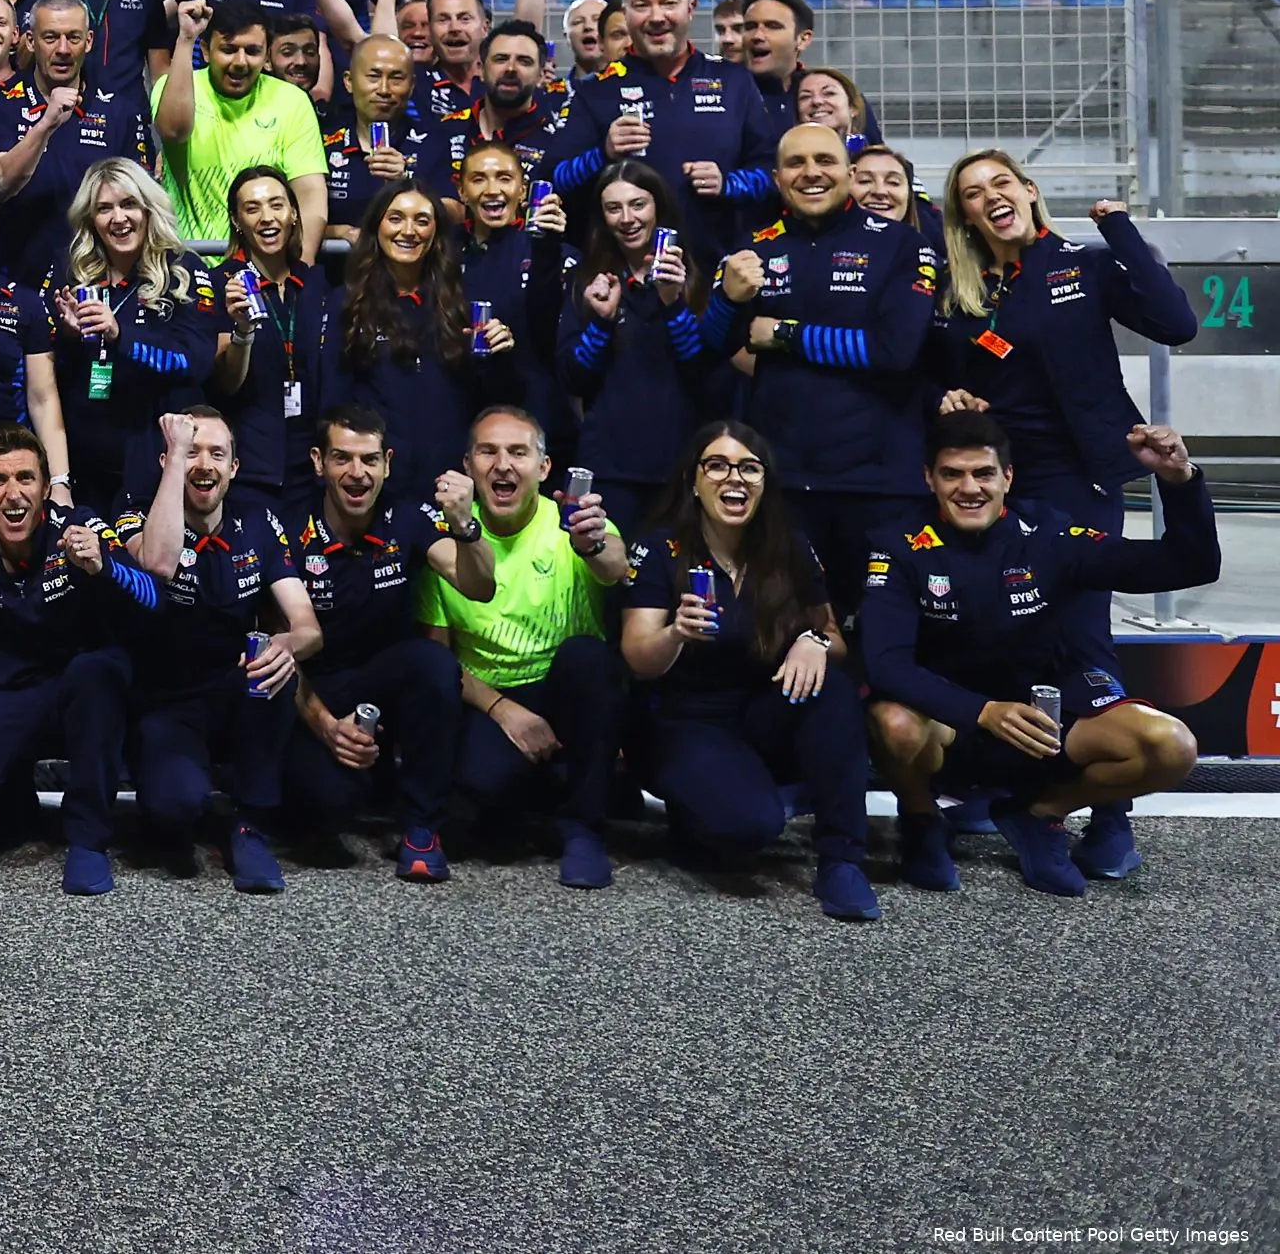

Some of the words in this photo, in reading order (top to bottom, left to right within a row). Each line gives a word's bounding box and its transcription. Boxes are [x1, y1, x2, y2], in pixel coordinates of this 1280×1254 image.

[27, 88, 36, 105] zoom
[81, 129, 104, 138] BYBIT
[833, 271, 863, 282] BYBIT
[1052, 283, 1080, 296] BYBIT
[1051, 293, 1086, 304] HONDA
[1203, 276, 1253, 328] 24
[317, 521, 329, 542] zoom
[306, 556, 327, 565] TAG
[374, 563, 402, 578] BYBIT
[43, 575, 69, 592] BYBIT
[238, 573, 260, 588] BYBIT
[374, 578, 407, 589] HONDA
[1010, 588, 1040, 604] BYBIT
